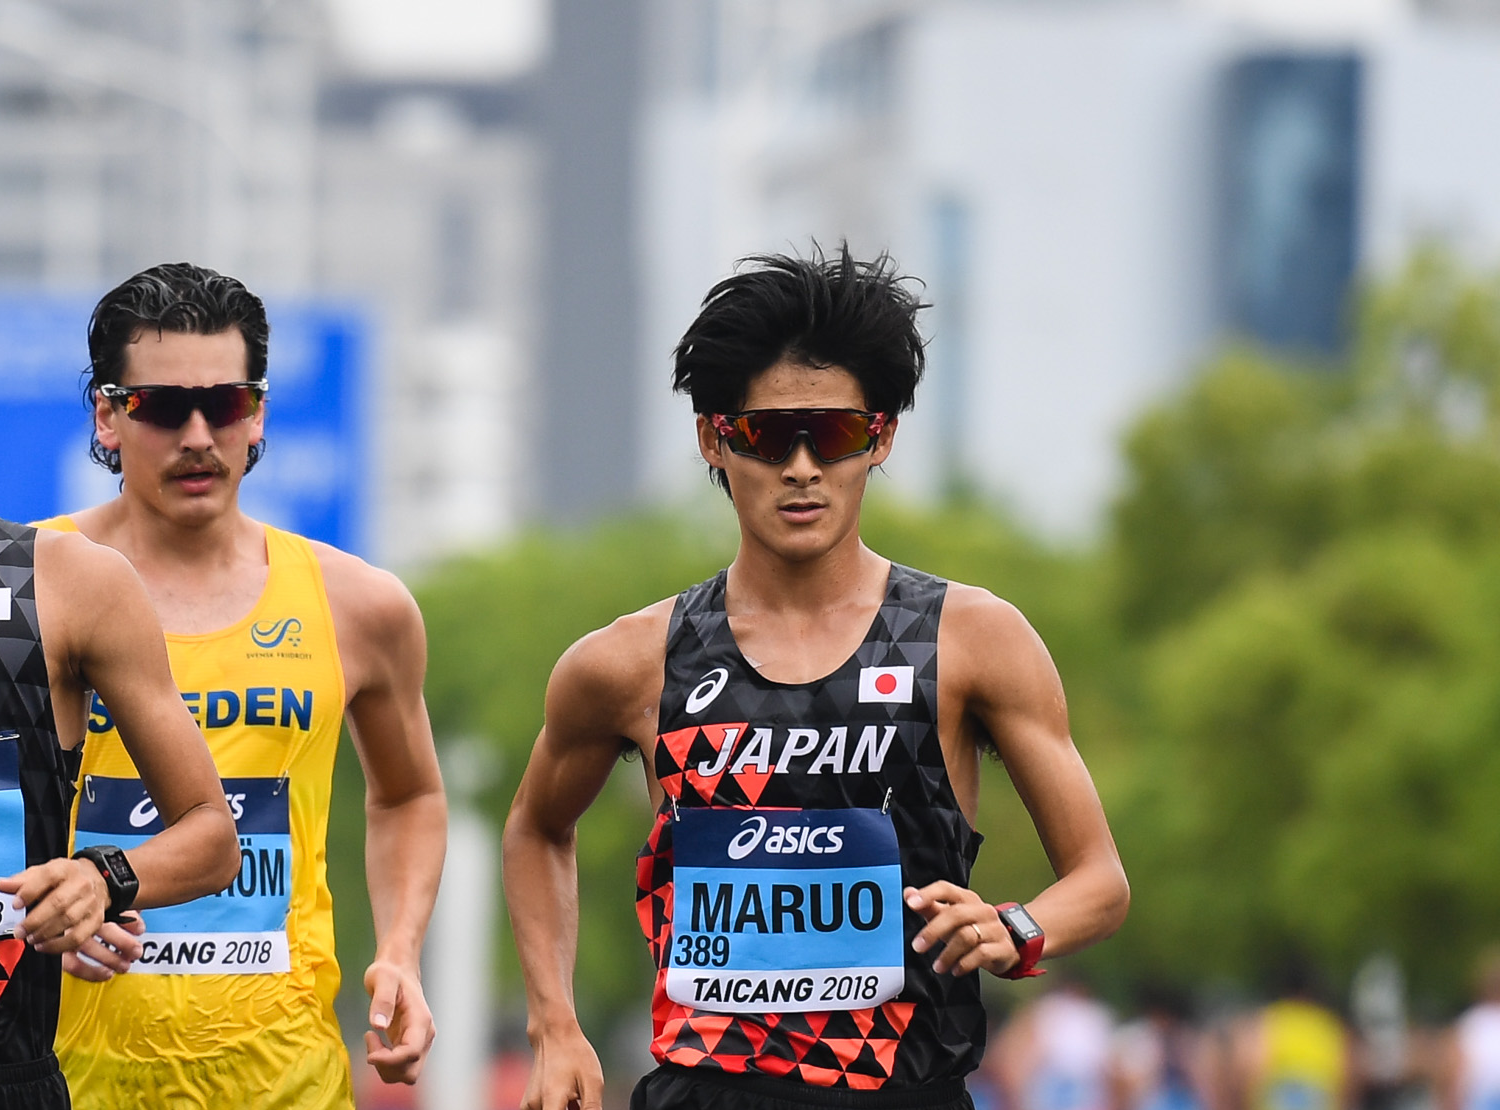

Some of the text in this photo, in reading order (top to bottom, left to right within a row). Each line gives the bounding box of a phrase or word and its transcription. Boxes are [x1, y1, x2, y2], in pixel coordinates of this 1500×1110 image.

[87, 686, 314, 734] SEDEN
[697, 724, 898, 778] JAPAN
[764, 824, 845, 855] asics
[689, 880, 884, 935] MARUO
[130, 939, 273, 966] CANG 2018
[674, 934, 731, 968] 389
[692, 974, 880, 1004] TAICANG 2018
